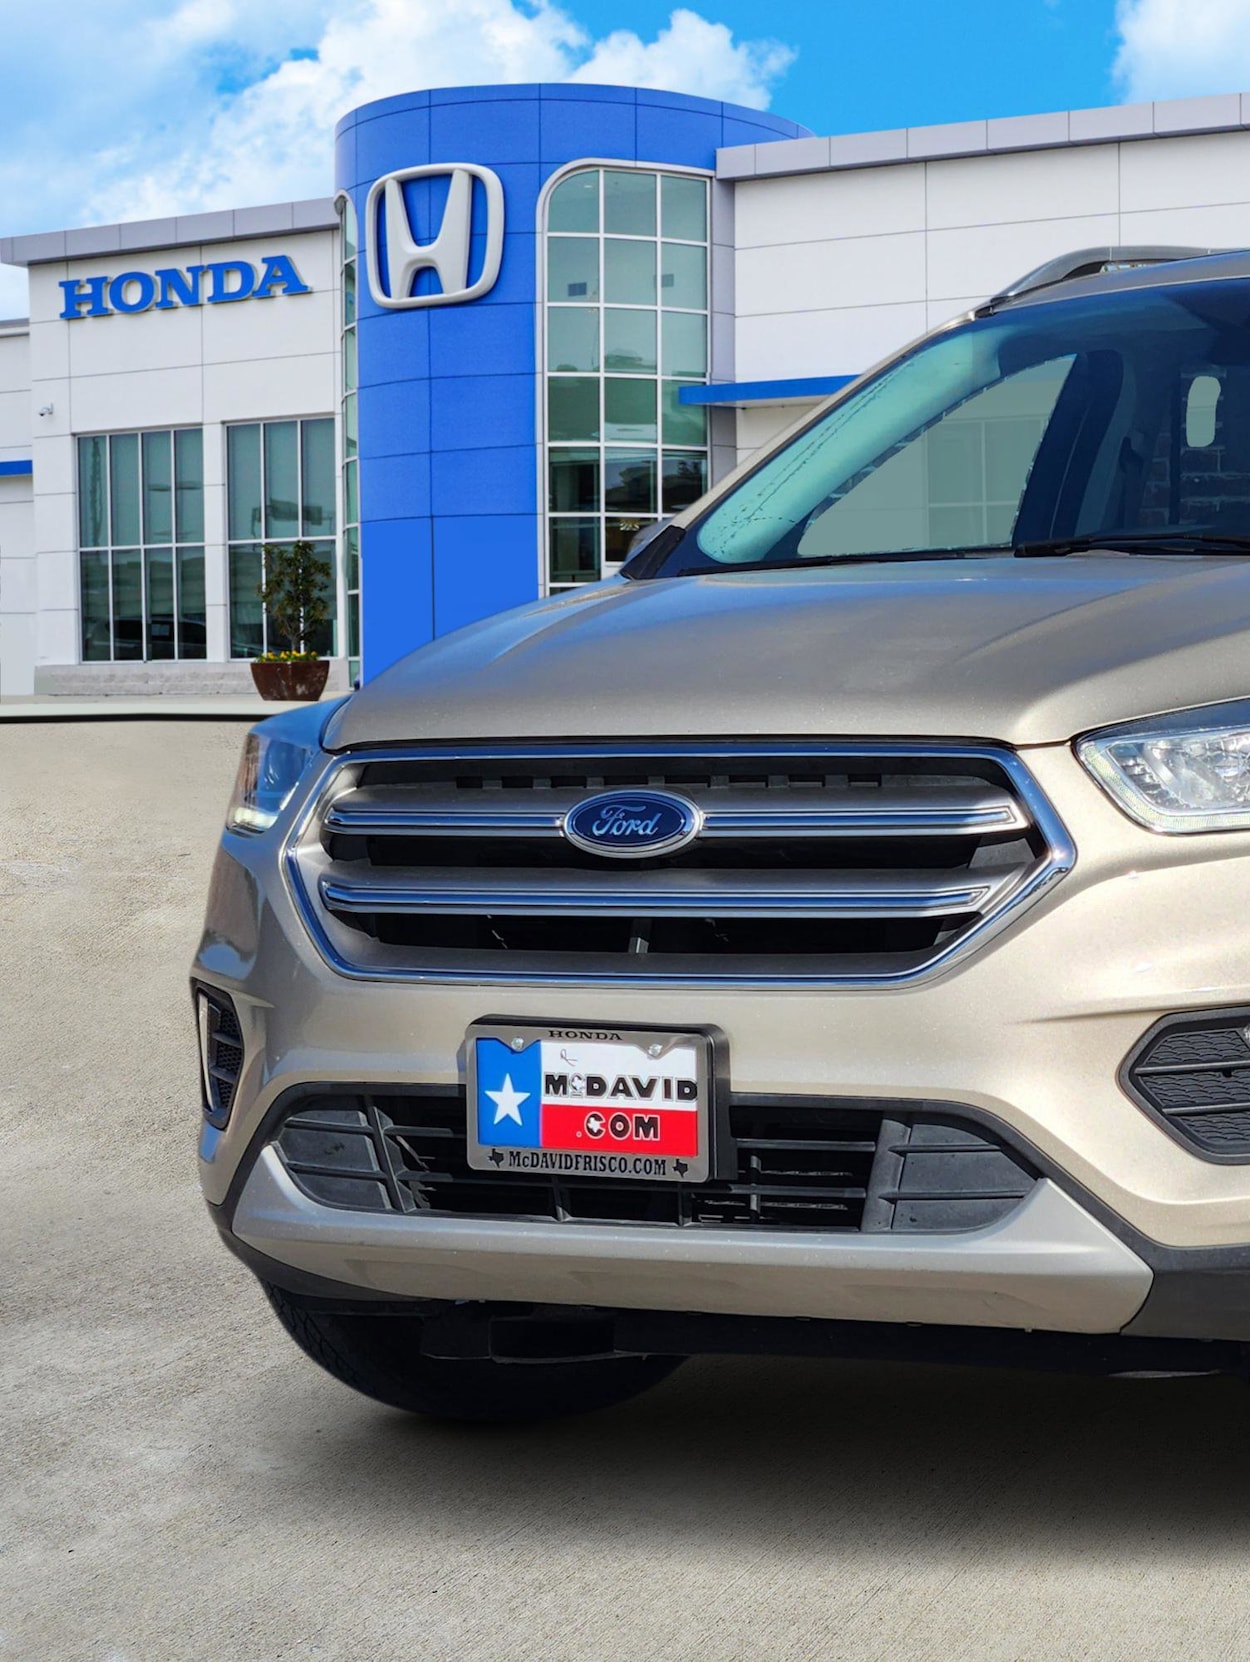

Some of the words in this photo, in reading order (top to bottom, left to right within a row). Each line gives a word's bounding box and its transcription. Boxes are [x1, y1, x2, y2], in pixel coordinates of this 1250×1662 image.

[58, 254, 309, 319] HONDA
[592, 804, 662, 836] Ford
[548, 1030, 623, 1041] HONDA
[508, 1151, 667, 1176] McDAVIDFRISCO.COM
